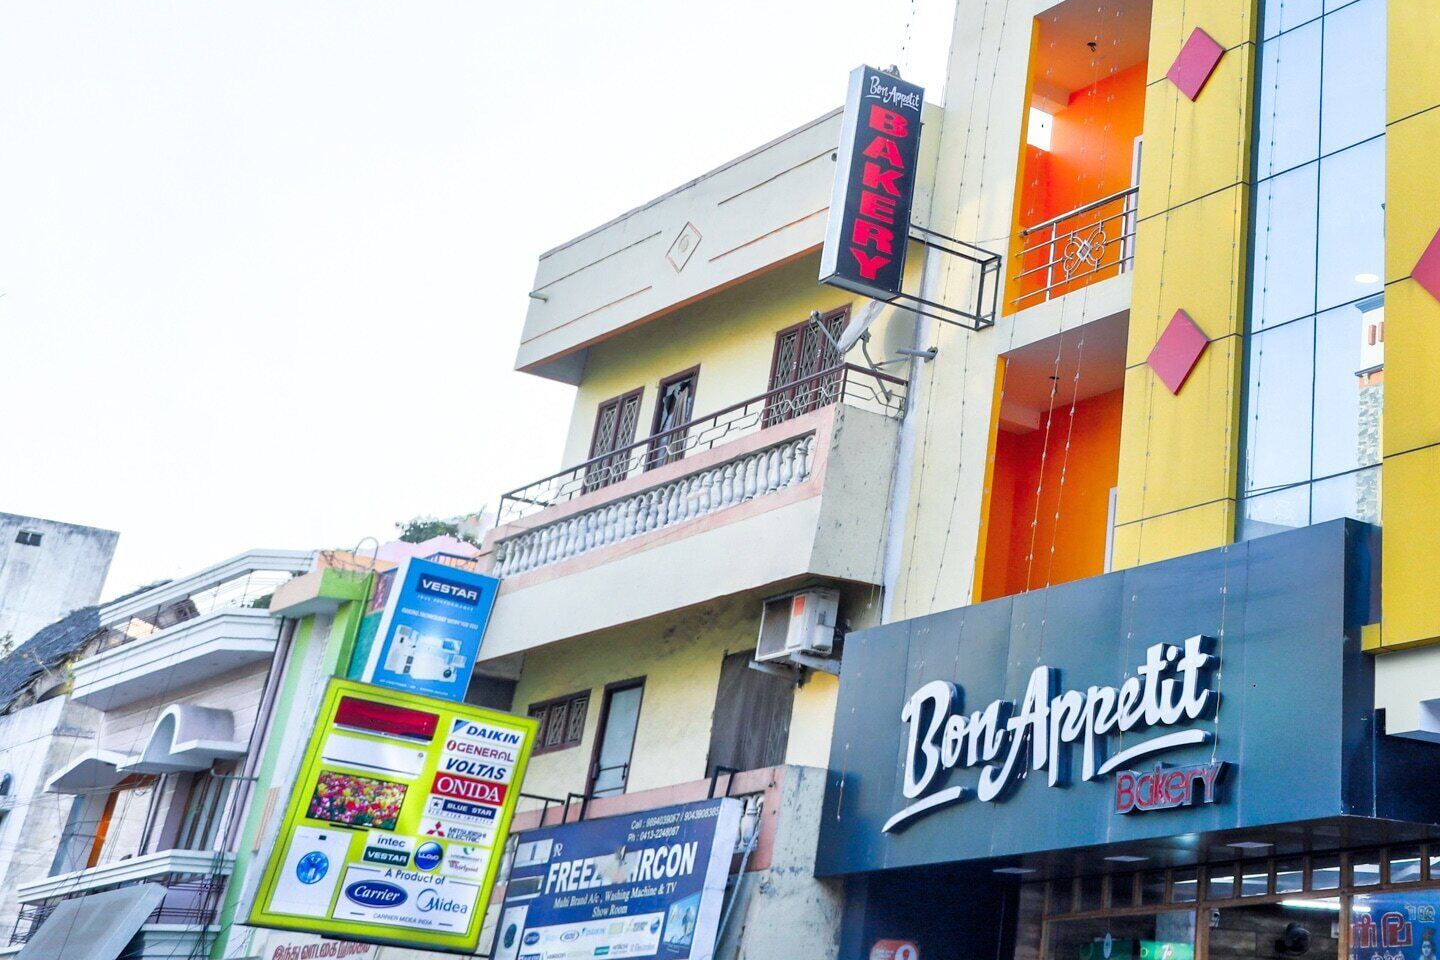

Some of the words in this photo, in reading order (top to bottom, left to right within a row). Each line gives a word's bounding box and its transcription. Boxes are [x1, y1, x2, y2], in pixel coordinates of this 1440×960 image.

[869, 75, 889, 99] Bon
[883, 87, 920, 109] Appetit
[850, 104, 908, 280] BAKERY
[422, 579, 478, 600] VESTAR
[901, 679, 1008, 800] Bon
[978, 634, 1211, 802] Appetit
[466, 725, 520, 744] DAIKIN
[456, 742, 514, 762] GENERAL
[445, 758, 507, 780] VOLTAS
[436, 776, 500, 802] ONIDA
[1115, 764, 1222, 814] Bakery
[446, 802, 468, 812] BLUE
[471, 807, 493, 816] STAR
[377, 835, 406, 848] intec
[367, 850, 407, 864] VESTAR
[384, 868, 393, 878] A
[395, 869, 433, 883] Product
[435, 876, 446, 885] of
[354, 885, 400, 902] Carrier
[553, 897, 570, 909] Multi
[570, 894, 588, 906] Brand
[604, 889, 630, 904] Washing
[631, 885, 657, 898] Machine
[665, 882, 677, 894] TV
[592, 906, 608, 918] Show
[609, 905, 628, 916] Room
